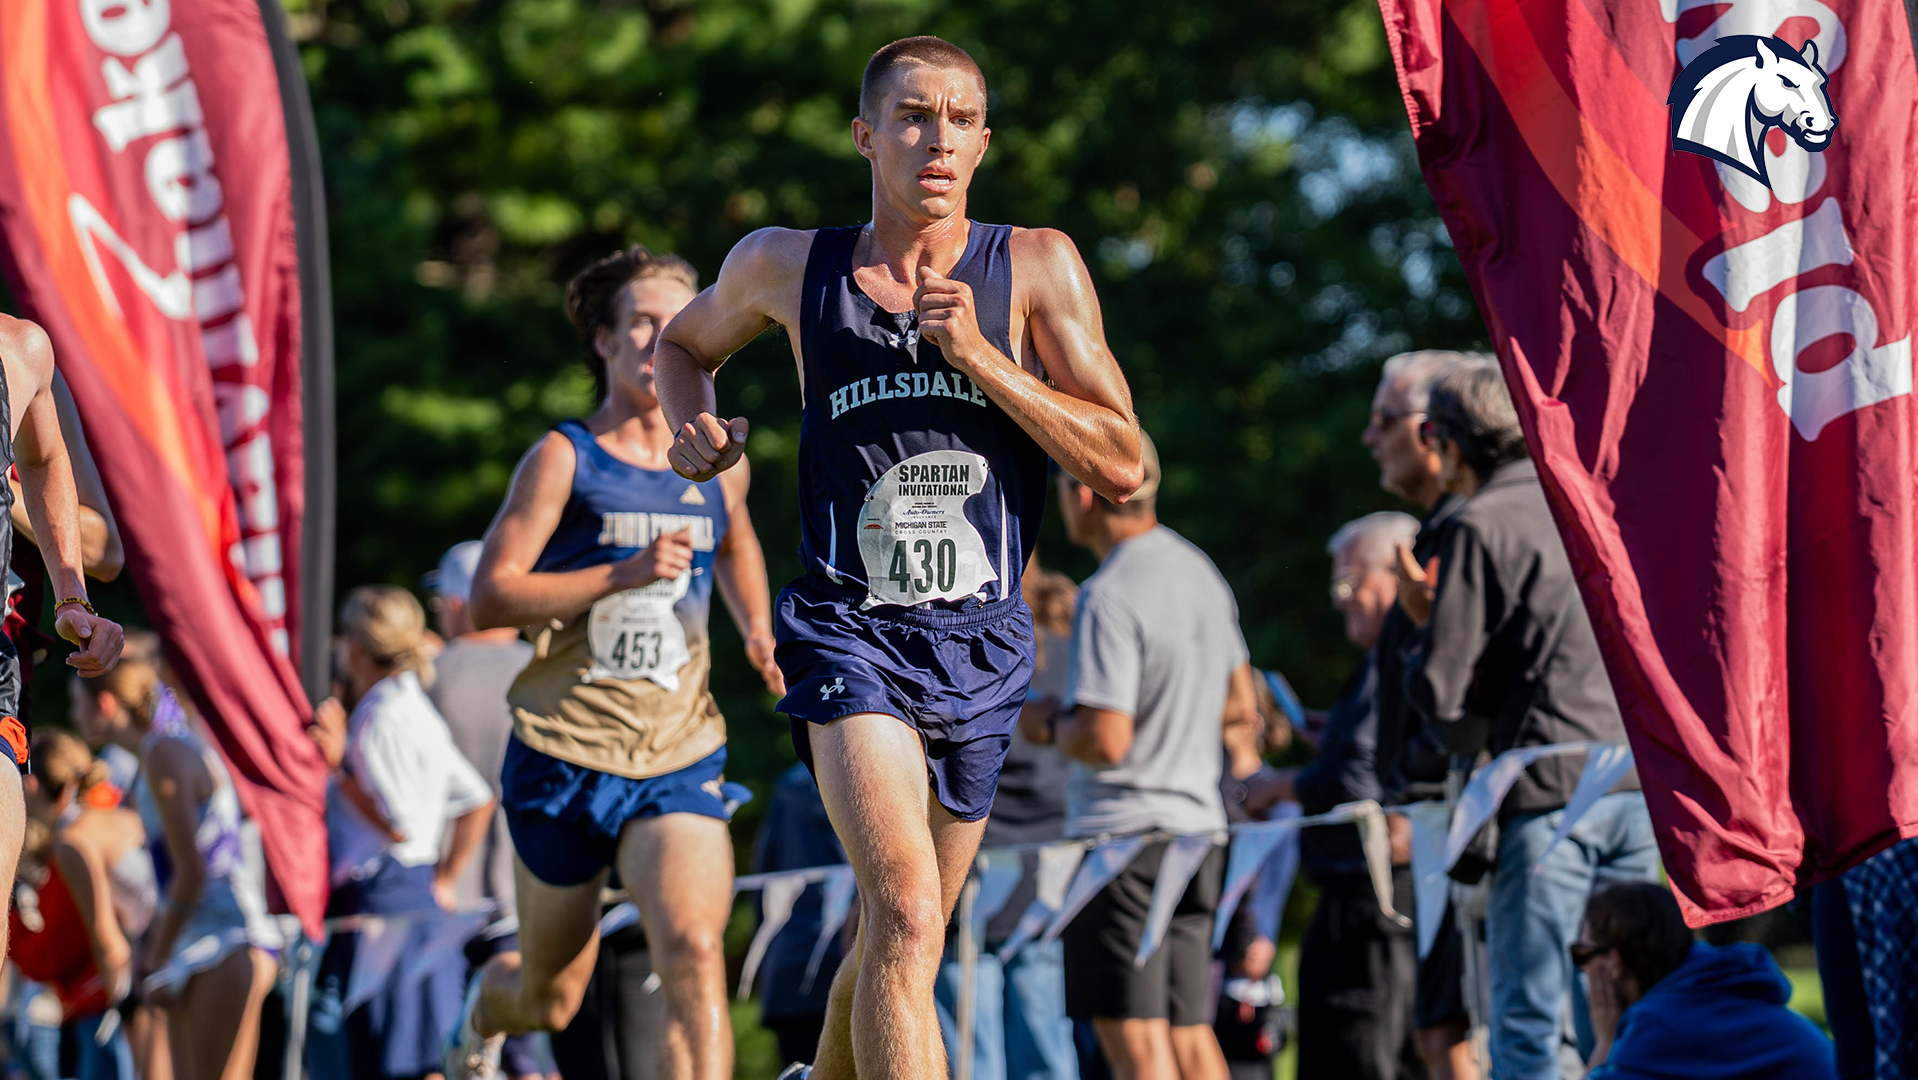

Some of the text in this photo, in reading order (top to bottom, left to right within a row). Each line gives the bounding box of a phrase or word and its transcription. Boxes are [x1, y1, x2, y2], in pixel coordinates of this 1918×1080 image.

[829, 371, 987, 420] HILLSDALE
[899, 464, 970, 483] SPARTAN
[898, 485, 970, 496] INVITATIONAL
[895, 521, 947, 529] MICHIGAN STATE
[889, 539, 957, 594] 430
[611, 631, 663, 671] 453
